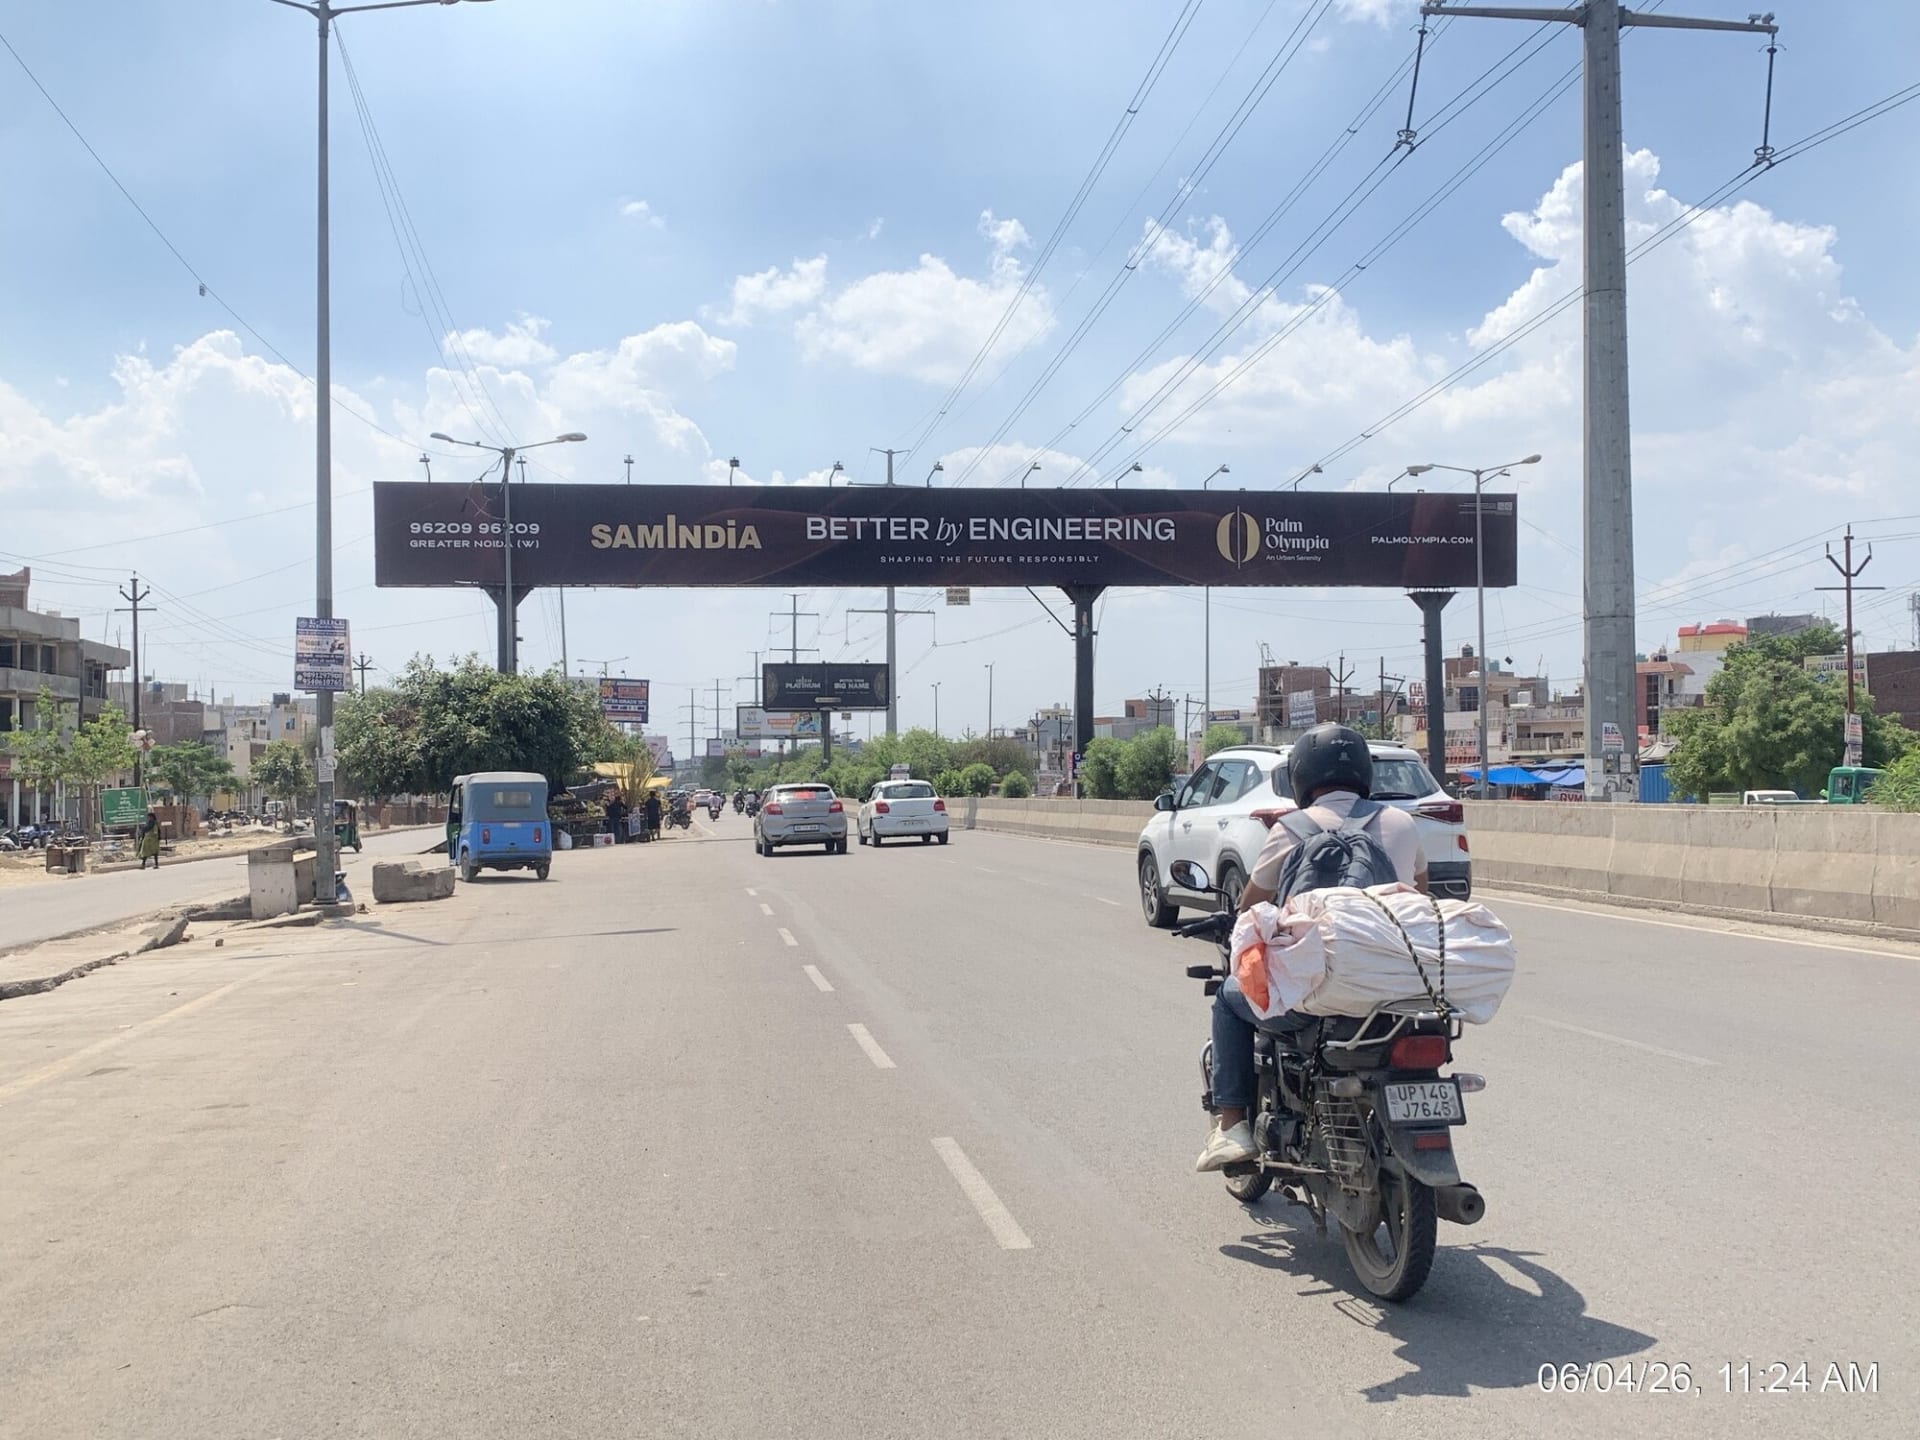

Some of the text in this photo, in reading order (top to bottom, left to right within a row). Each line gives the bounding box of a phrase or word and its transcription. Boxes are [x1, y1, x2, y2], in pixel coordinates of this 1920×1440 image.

[410, 523, 472, 534] 96209
[1265, 518, 1303, 532] Palm
[806, 517, 1176, 546] BETTER by ENGINEERING
[409, 540, 470, 548] GREATER
[517, 540, 540, 549] (W)
[1265, 534, 1329, 552] Olympia
[1371, 536, 1474, 544] PALMOLYMPIA.COM
[1296, 554, 1322, 562] Serenity
[1403, 1101, 1452, 1118] J7645
